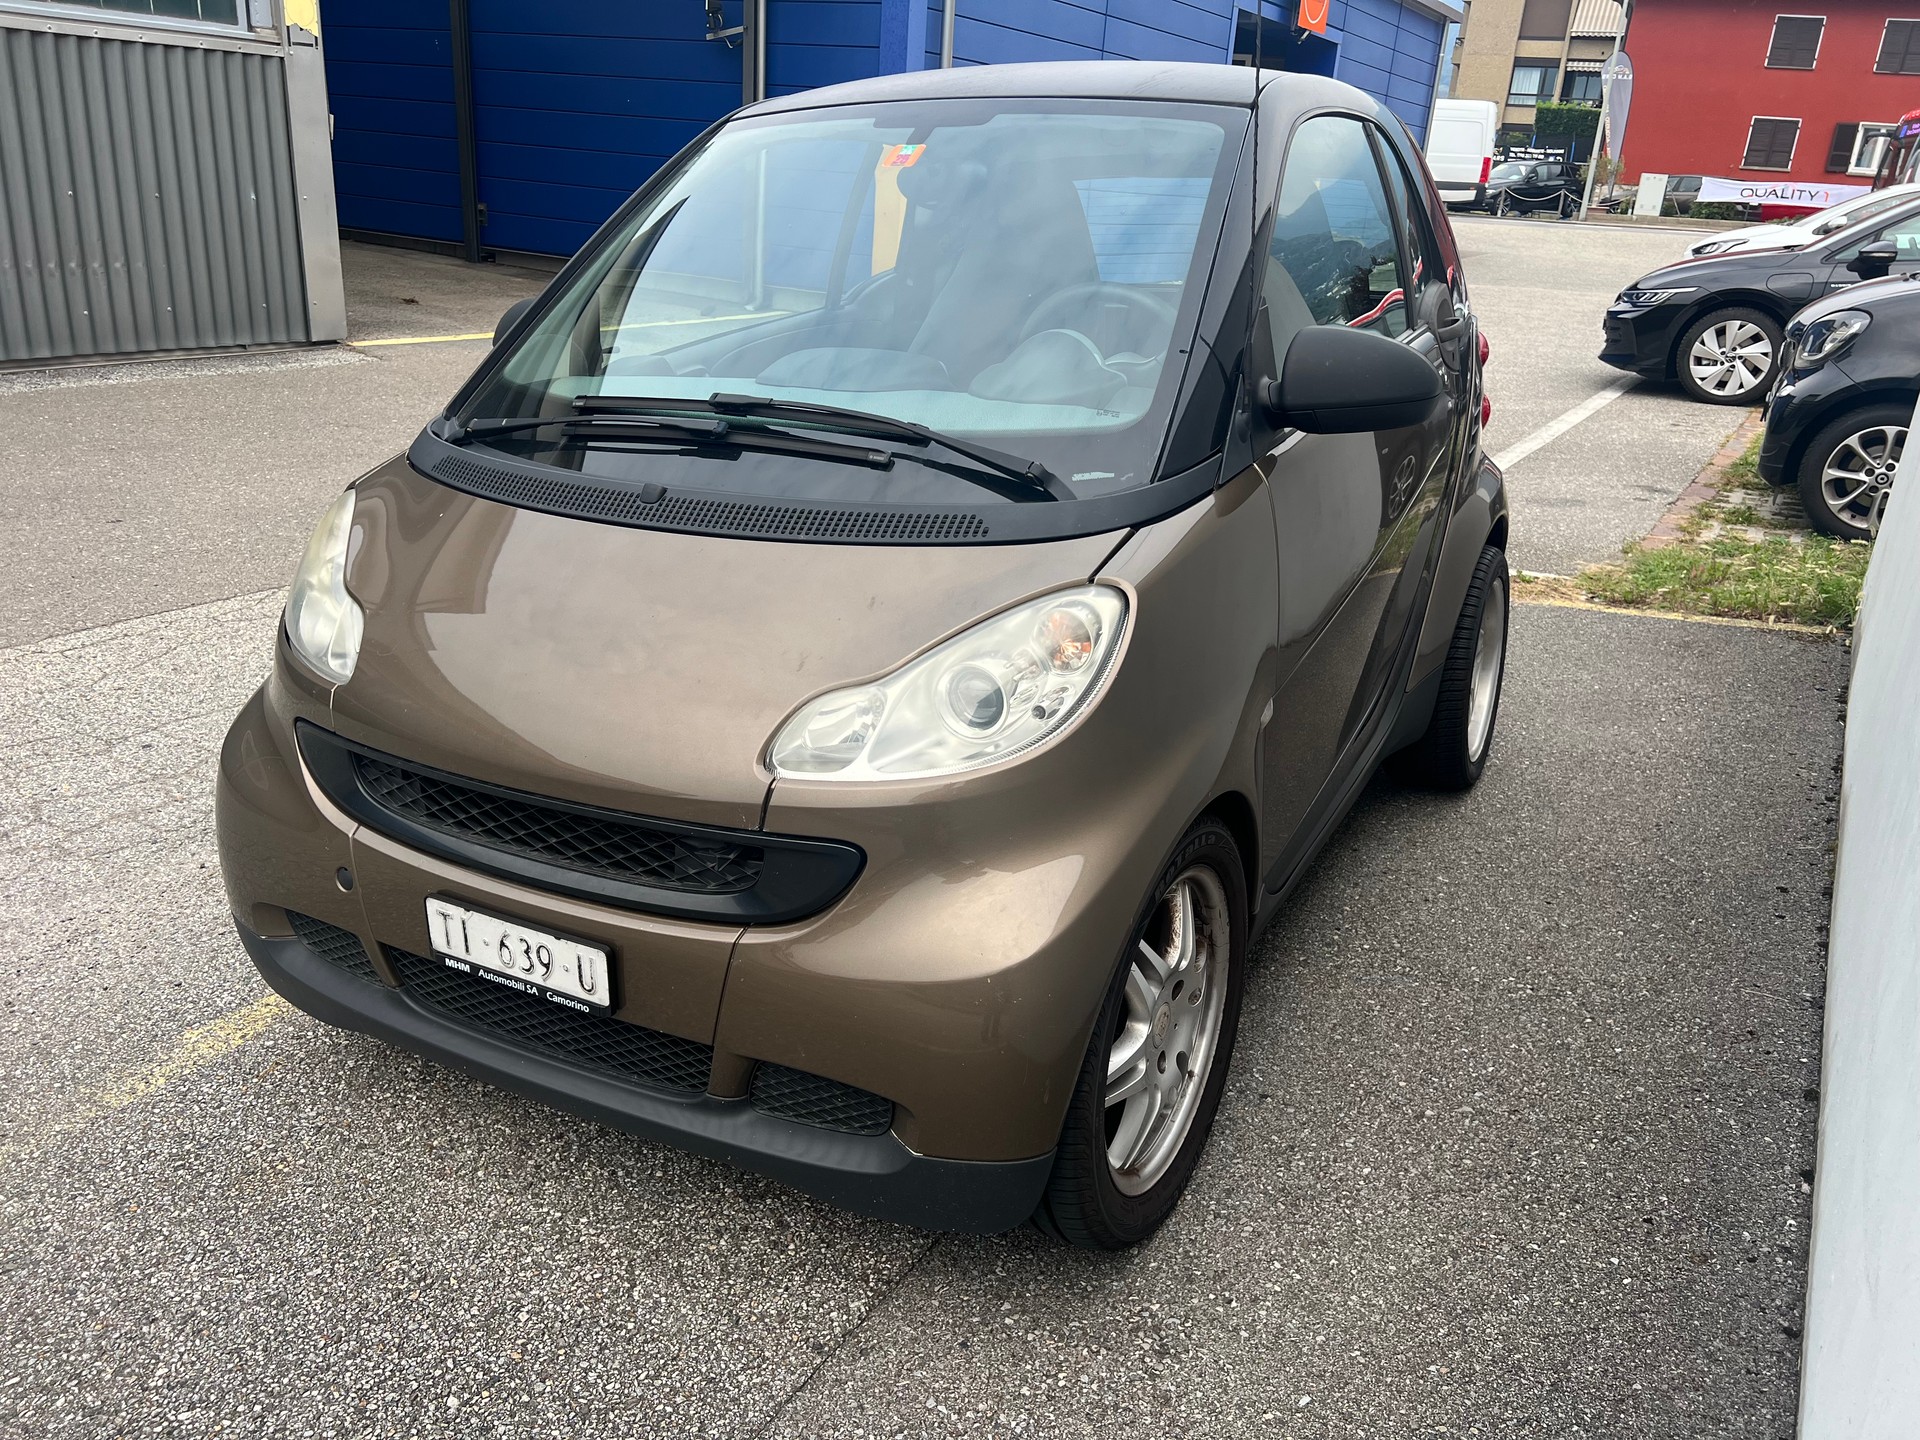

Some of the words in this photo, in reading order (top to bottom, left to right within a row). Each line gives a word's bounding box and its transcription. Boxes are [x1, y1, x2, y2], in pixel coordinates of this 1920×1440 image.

[1740, 187, 1819, 201] QUALITY
[1824, 191, 1830, 203] 1
[436, 909, 472, 956] TI
[498, 929, 554, 983] 639
[576, 952, 597, 995] U
[445, 957, 471, 974] MHM
[478, 968, 525, 992] Automobili
[526, 984, 539, 997] SA
[546, 991, 590, 1013] Camorino
